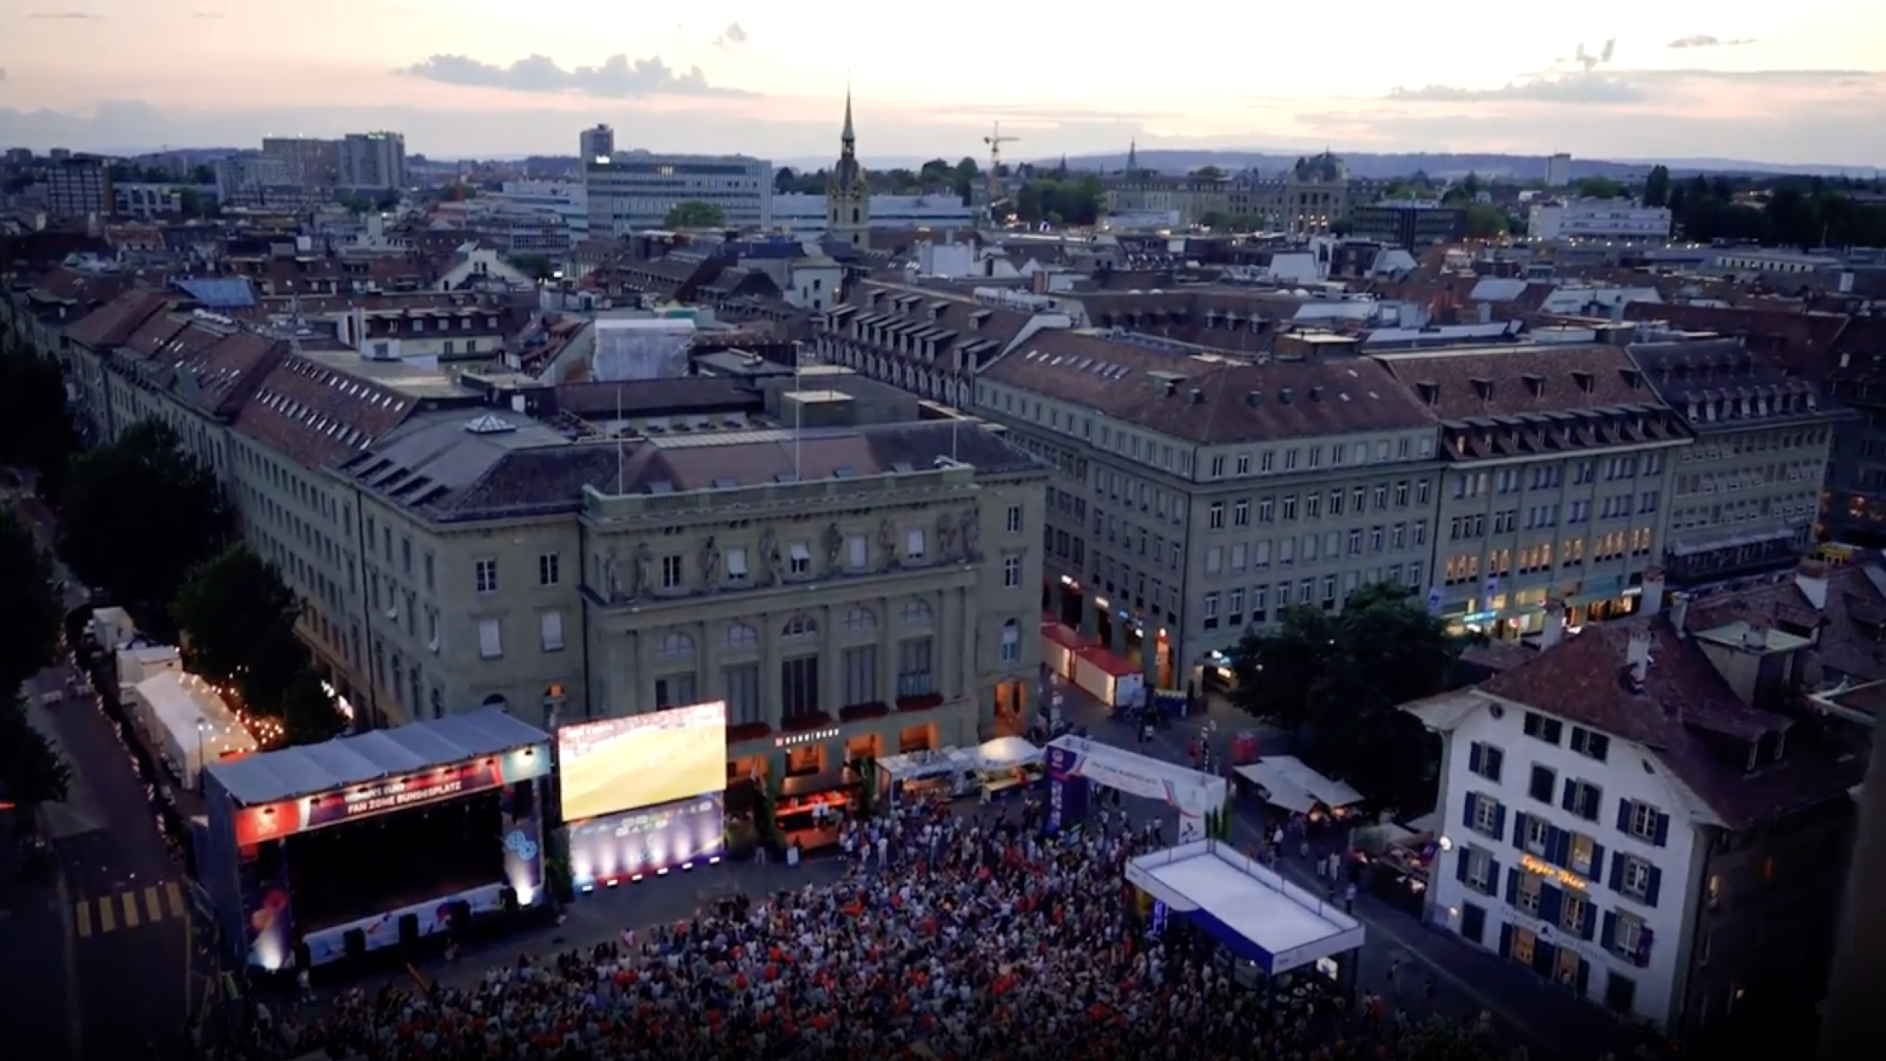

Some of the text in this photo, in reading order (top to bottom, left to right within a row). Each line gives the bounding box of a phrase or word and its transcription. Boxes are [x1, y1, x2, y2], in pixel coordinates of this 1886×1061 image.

[348, 781, 462, 814] FAN ZONE BUNDESPLATZ
